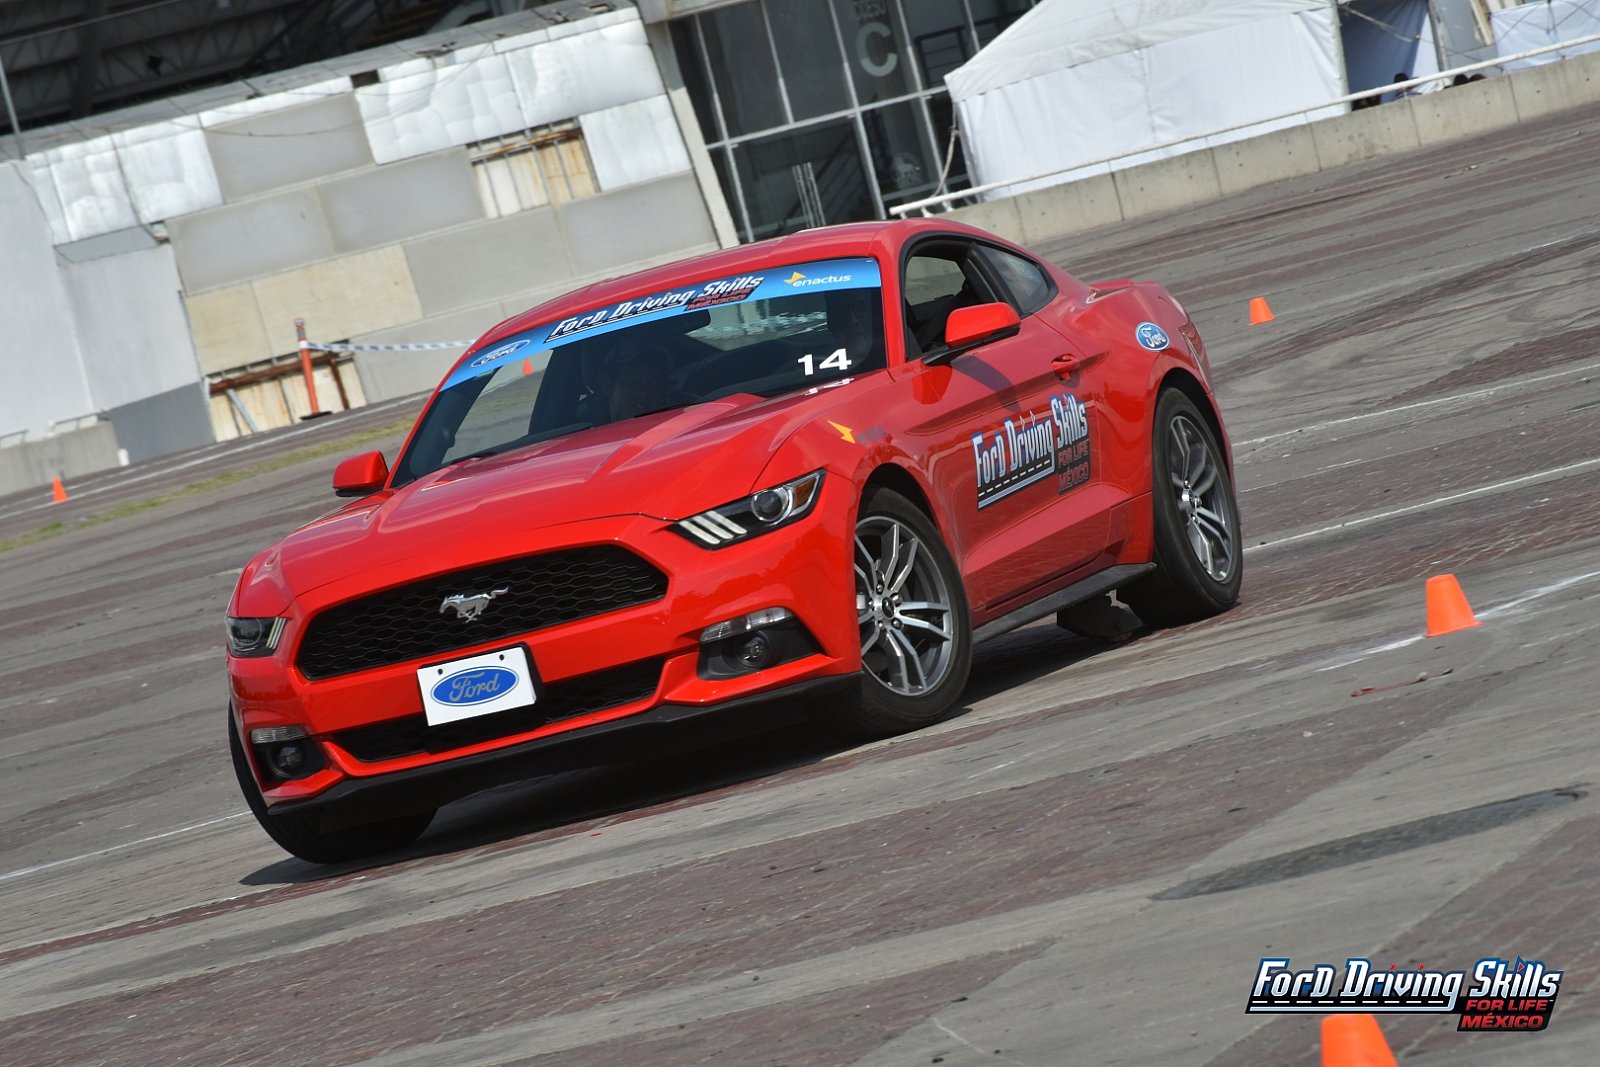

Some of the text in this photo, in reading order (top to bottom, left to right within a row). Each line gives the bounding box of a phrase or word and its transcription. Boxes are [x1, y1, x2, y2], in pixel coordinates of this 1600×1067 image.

[857, 22, 898, 77] C
[792, 275, 852, 288] enactus
[609, 290, 696, 318] Driving
[698, 276, 764, 297] Skills
[1139, 326, 1167, 348] Ford
[798, 348, 852, 376] 14
[1004, 411, 1055, 472] Driving
[1051, 394, 1088, 449] Skills
[449, 672, 501, 702] Ford
